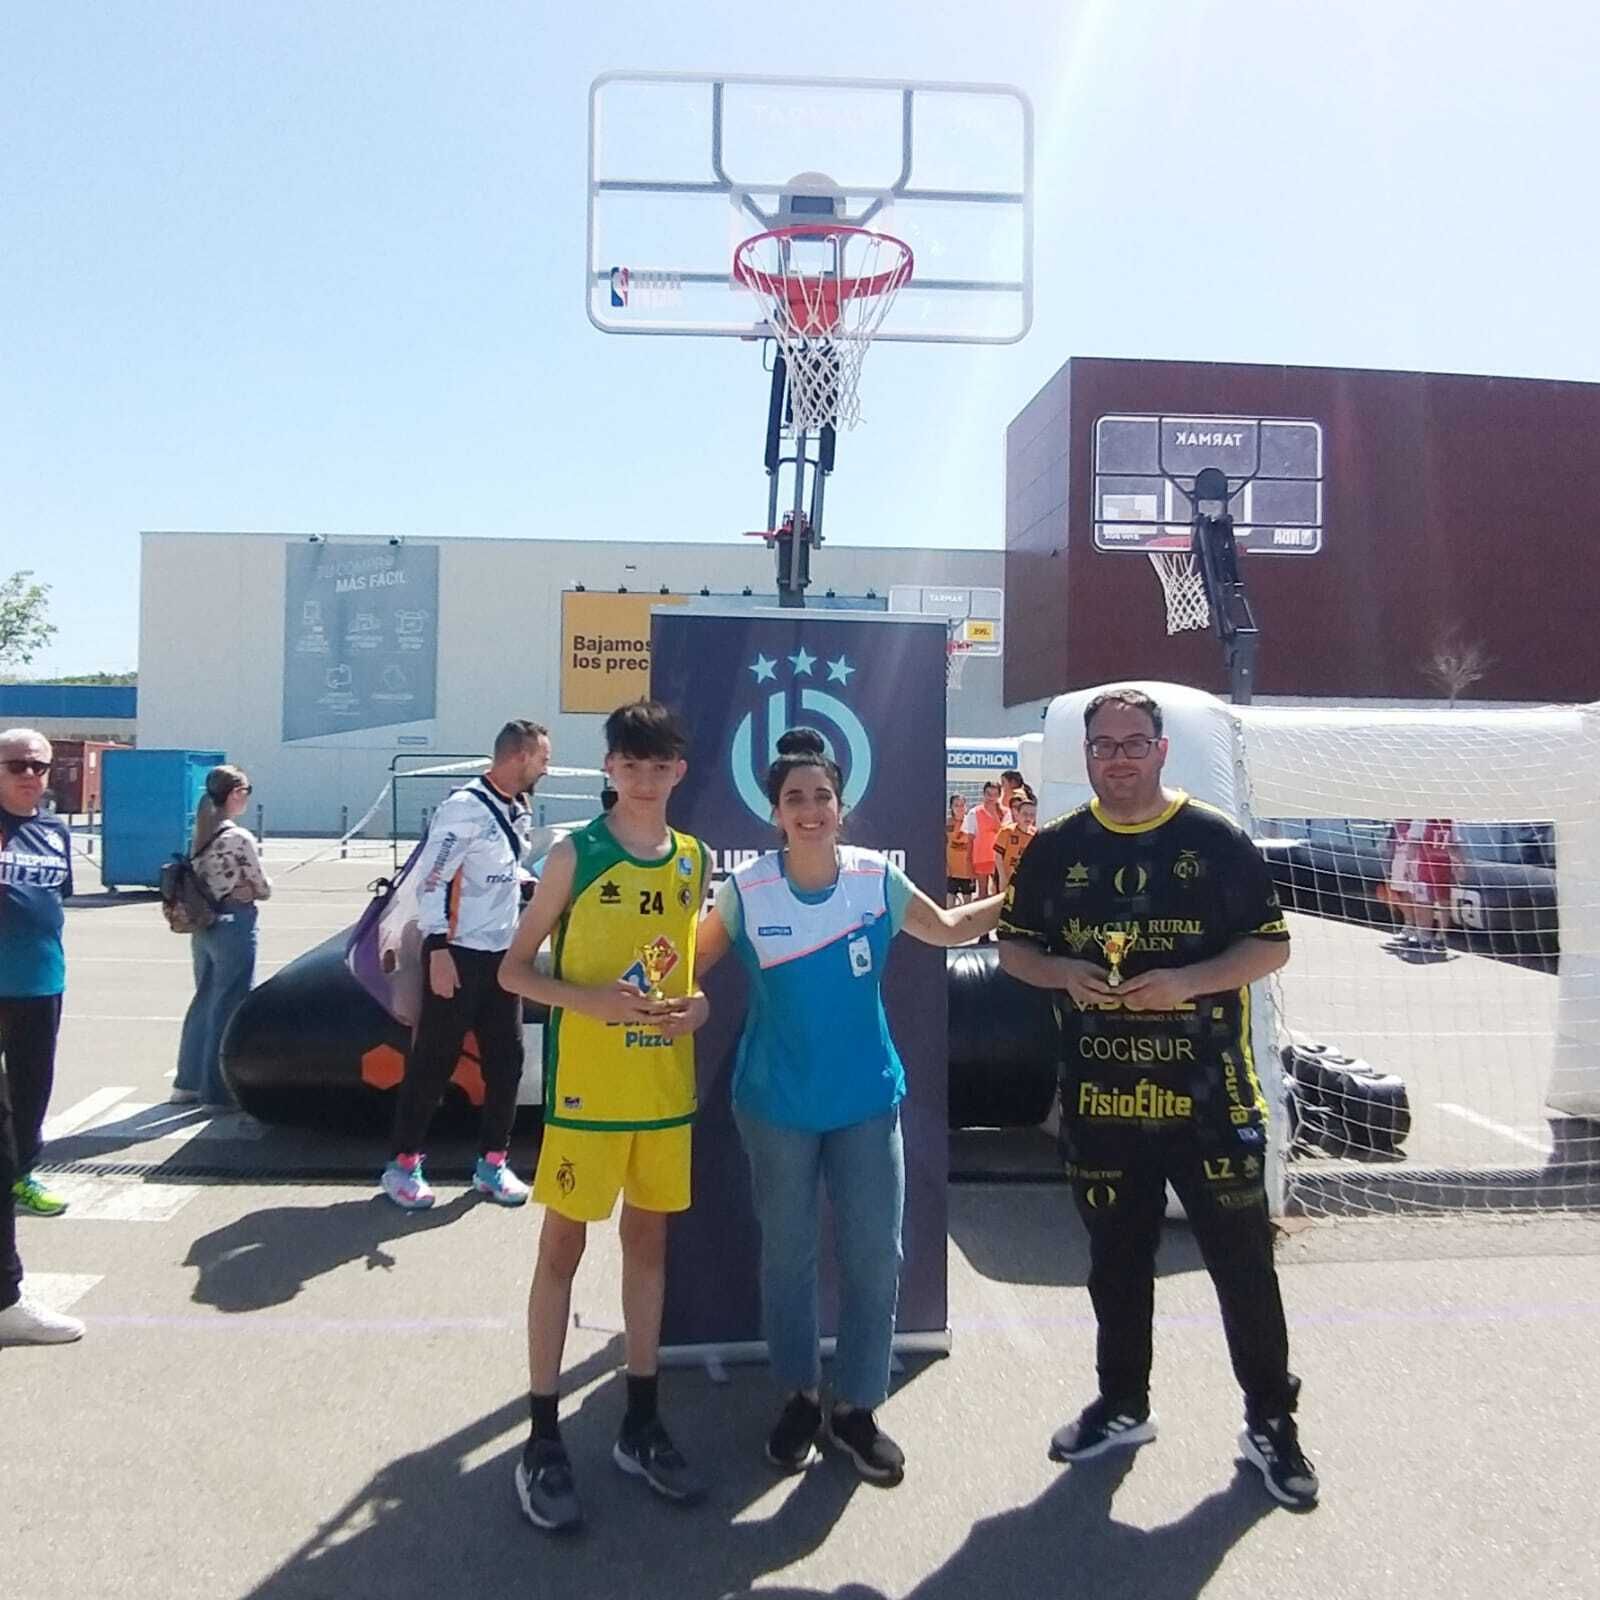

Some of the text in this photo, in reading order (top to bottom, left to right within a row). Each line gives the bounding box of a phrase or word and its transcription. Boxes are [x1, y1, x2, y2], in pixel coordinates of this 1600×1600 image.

[573, 653, 649, 674] los prec
[947, 753, 1014, 766] DECATHLON
[639, 891, 664, 915] 24
[1148, 919, 1204, 935] RURAL
[1078, 1036, 1196, 1063] COCISUR
[1077, 1077, 1193, 1119] FisioÉlite
[1203, 1158, 1235, 1180] LZ
